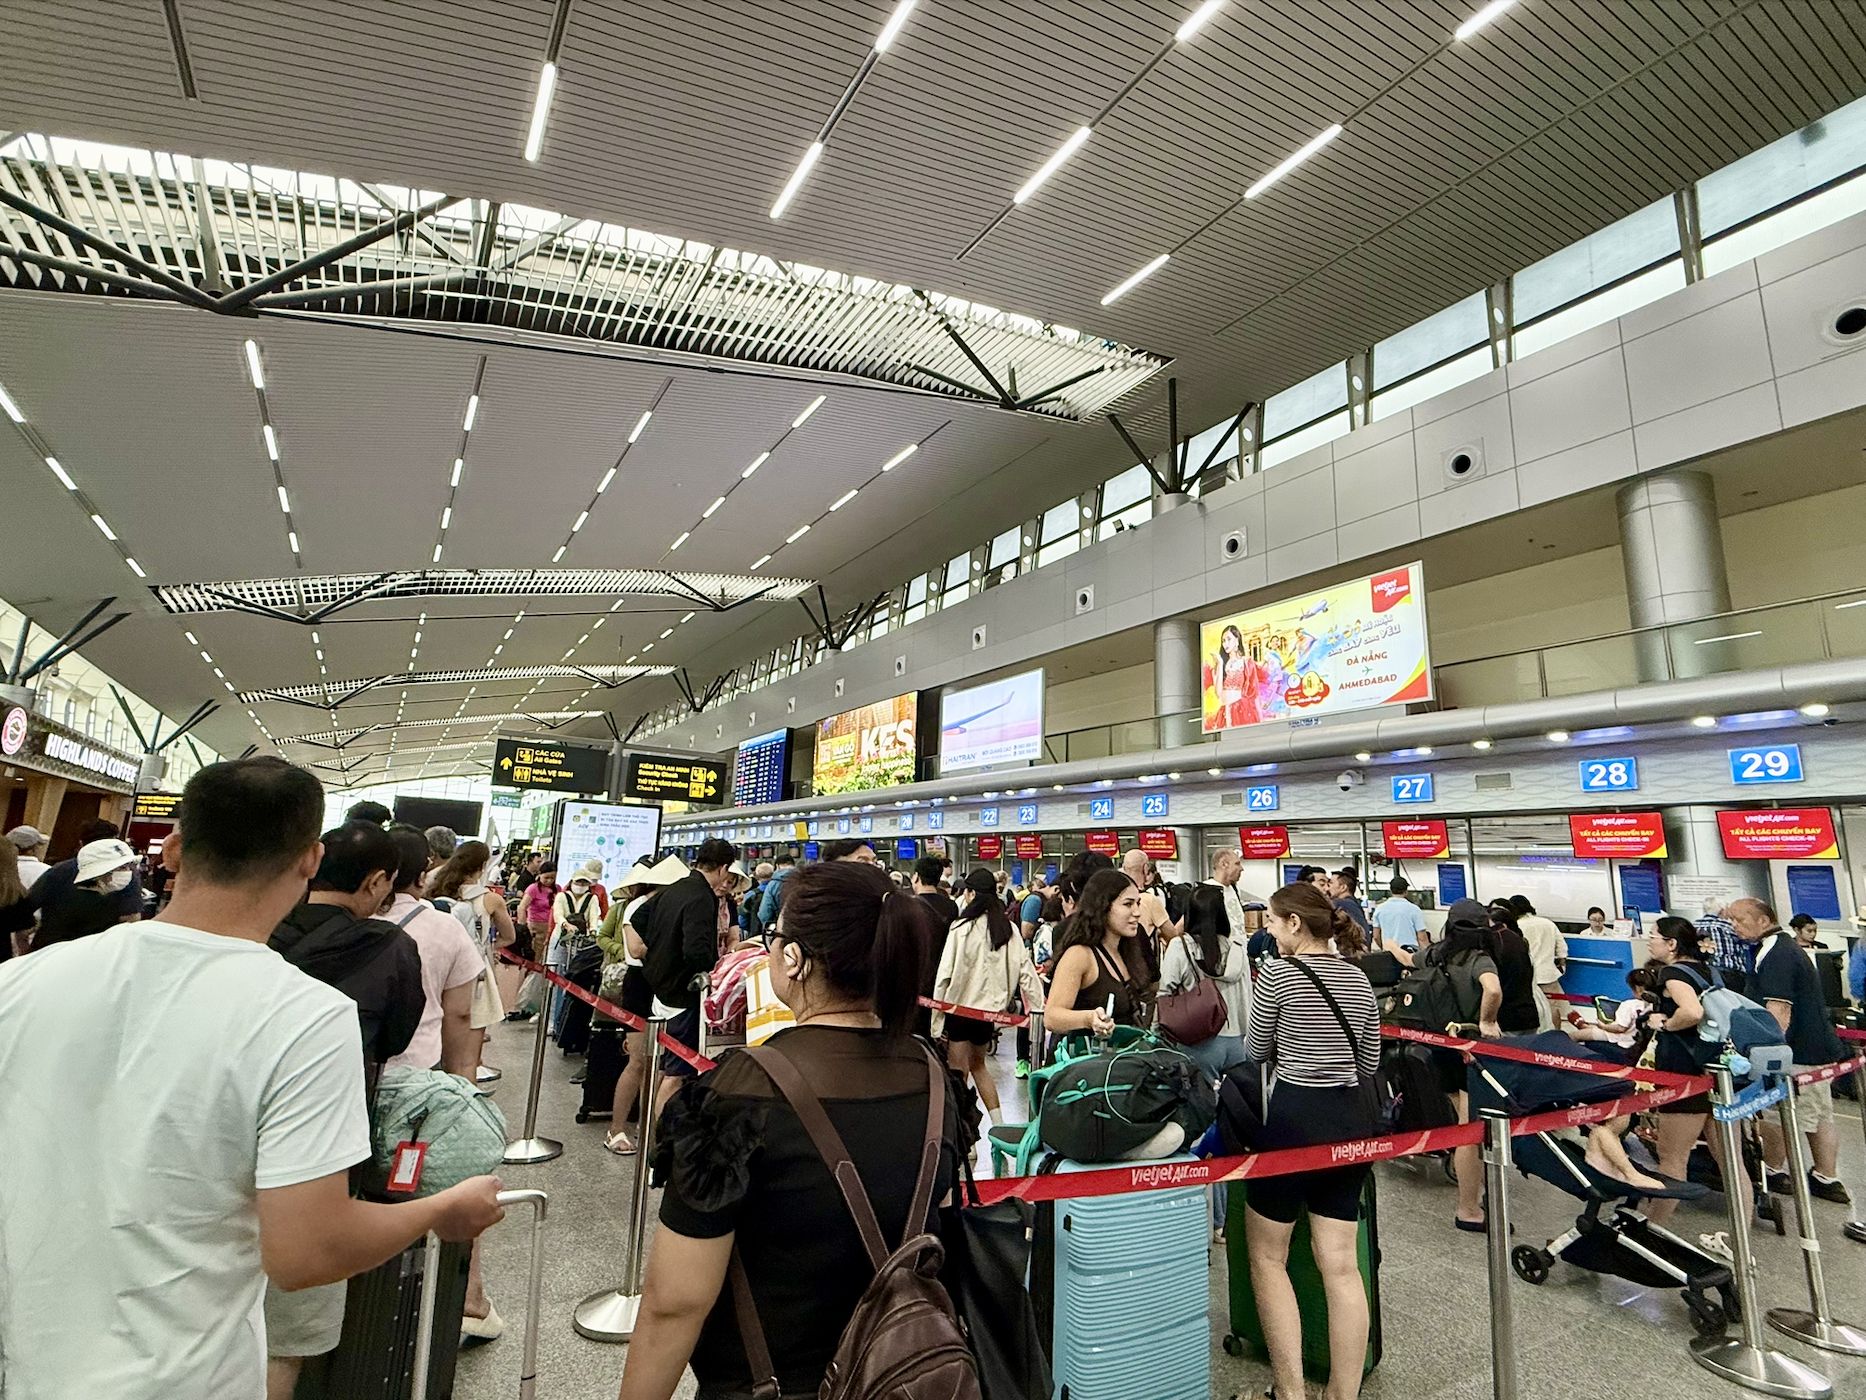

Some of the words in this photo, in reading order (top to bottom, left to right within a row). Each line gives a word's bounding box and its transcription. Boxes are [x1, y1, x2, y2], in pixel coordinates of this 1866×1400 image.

[1346, 656, 1359, 666] ĐÀ
[1338, 674, 1398, 691] AHMEDABAD
[44, 732, 108, 774] HIGHLANDS
[106, 756, 139, 784] COFFEE
[1739, 750, 1791, 778] 29
[532, 768, 547, 776] NHÀ
[558, 770, 574, 778] SINH
[1588, 762, 1628, 786] 28
[1397, 779, 1425, 799] 27
[1251, 790, 1272, 806] 26
[1094, 802, 1109, 816] 24
[1146, 798, 1163, 813] 25
[930, 815, 940, 826] 21
[984, 812, 995, 823] 22
[1021, 808, 1033, 821] 23
[902, 816, 912, 828] 20
